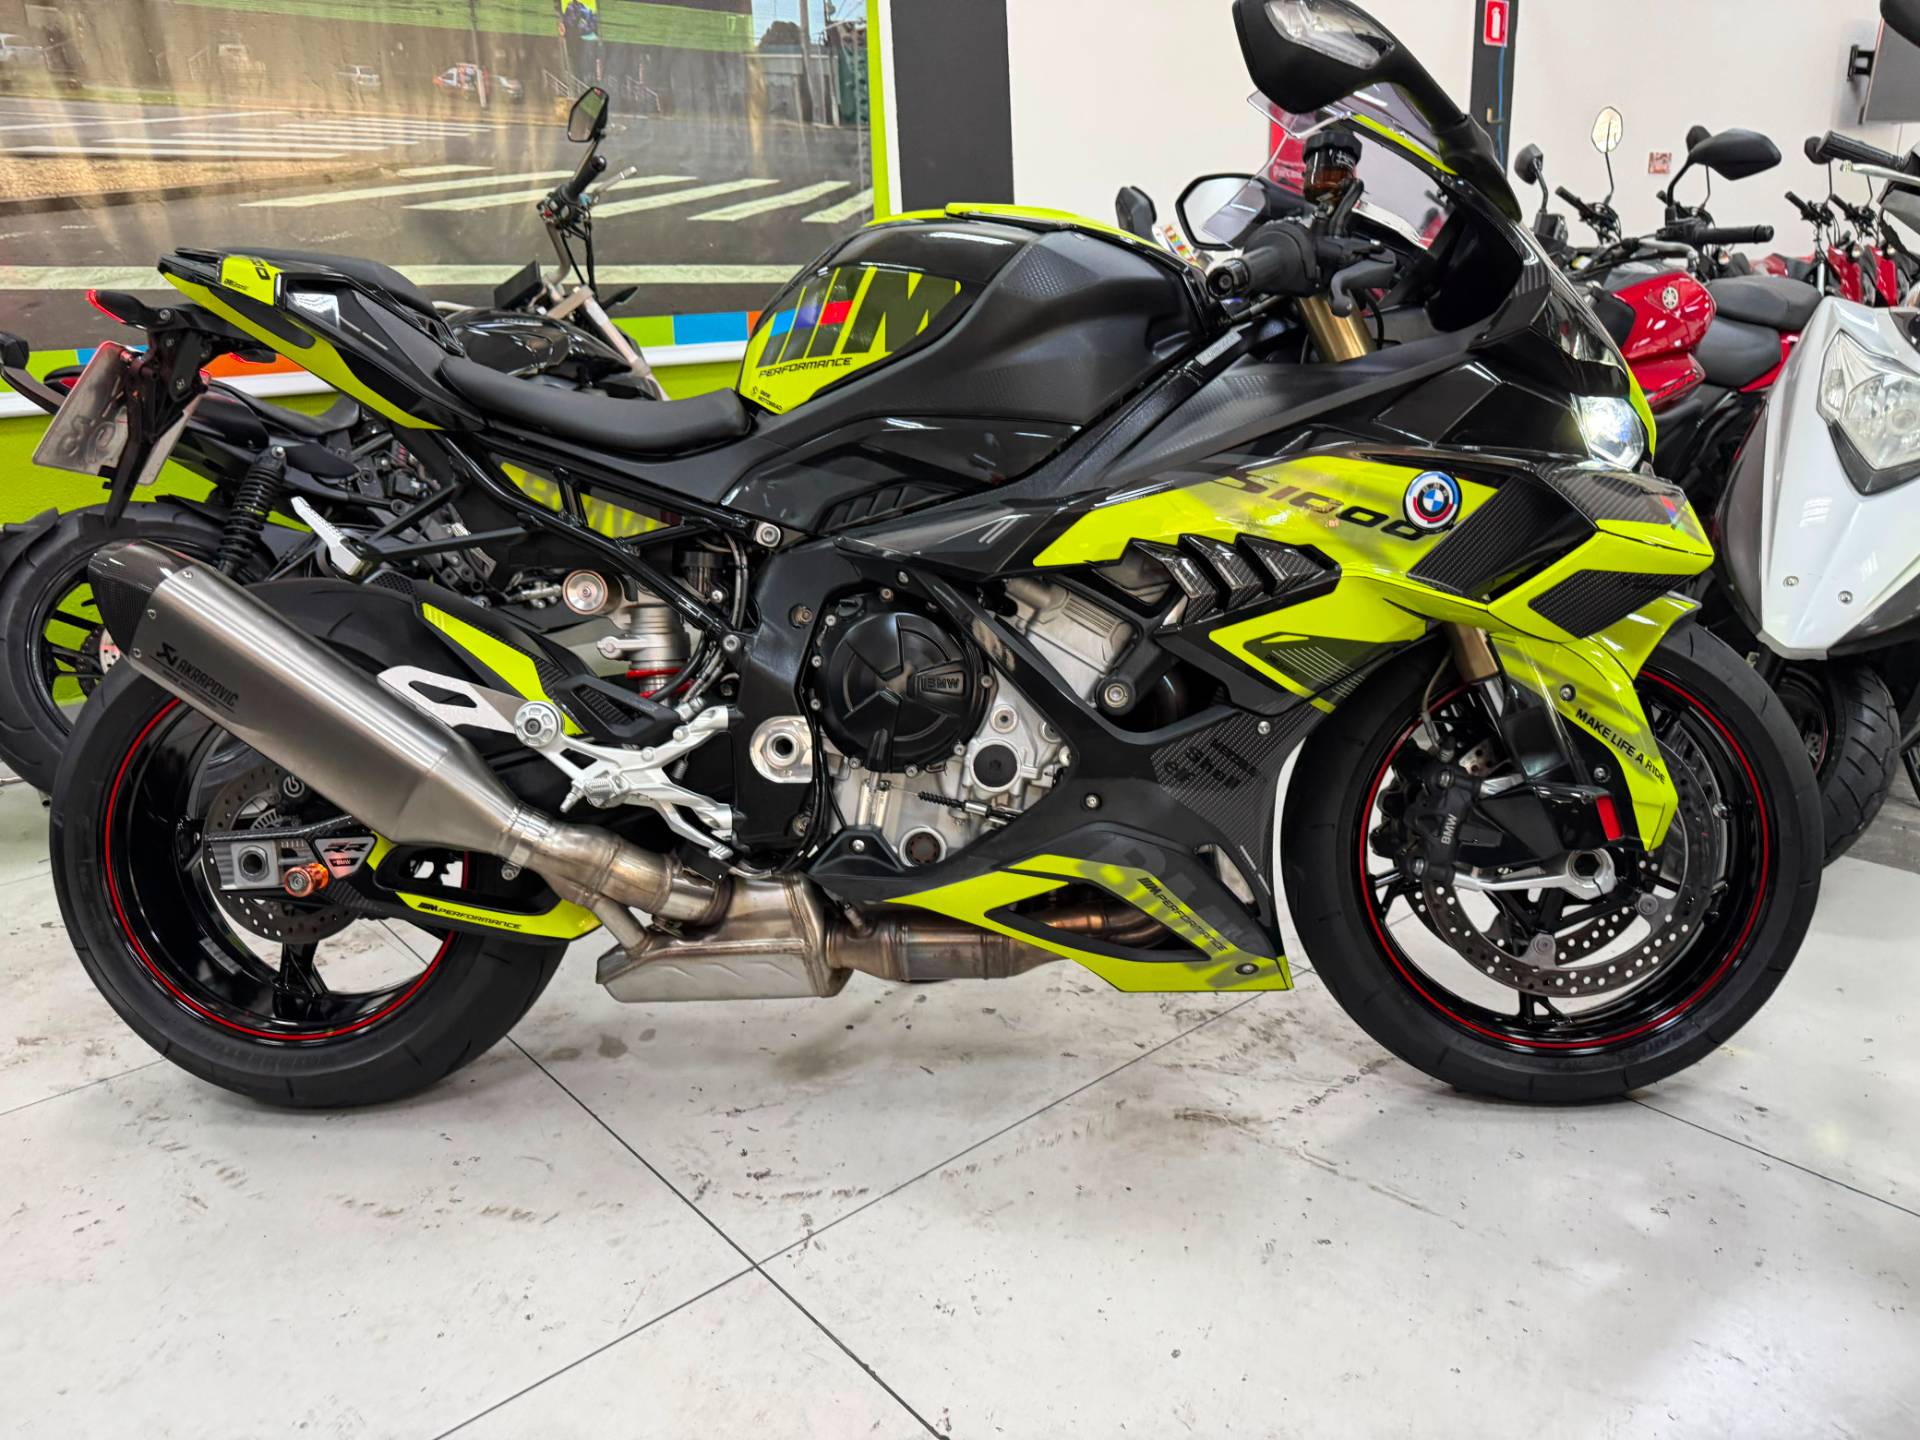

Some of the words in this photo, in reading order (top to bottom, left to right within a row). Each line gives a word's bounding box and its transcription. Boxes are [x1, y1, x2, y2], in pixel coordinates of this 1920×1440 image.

[758, 357, 853, 378] PERFORMANCE
[1575, 708, 1612, 739] MAKE
[1610, 733, 1636, 758] LIFE
[1635, 752, 1645, 765] A
[1645, 759, 1666, 785] RIDE
[1441, 813, 1457, 845] BMW
[438, 908, 522, 929] PERFORMANCE
[1157, 895, 1229, 952] PERFORMANCE
